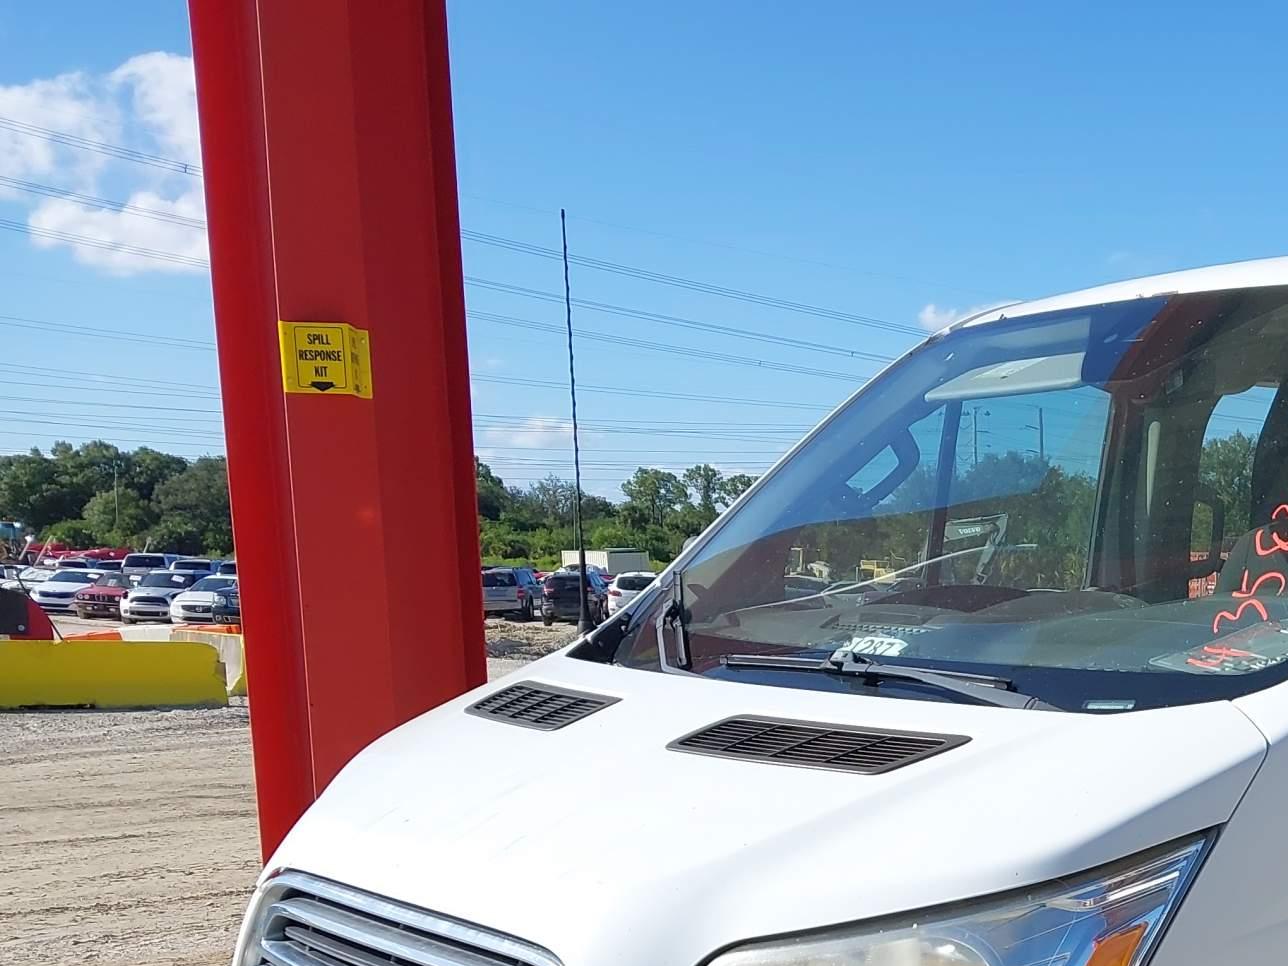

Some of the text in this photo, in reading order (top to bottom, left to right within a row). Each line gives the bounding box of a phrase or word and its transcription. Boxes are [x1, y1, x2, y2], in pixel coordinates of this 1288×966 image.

[306, 333, 332, 345] SPILL
[298, 349, 343, 362] RESPONSE
[314, 366, 328, 377] KIT
[958, 526, 981, 535] VOLVO
